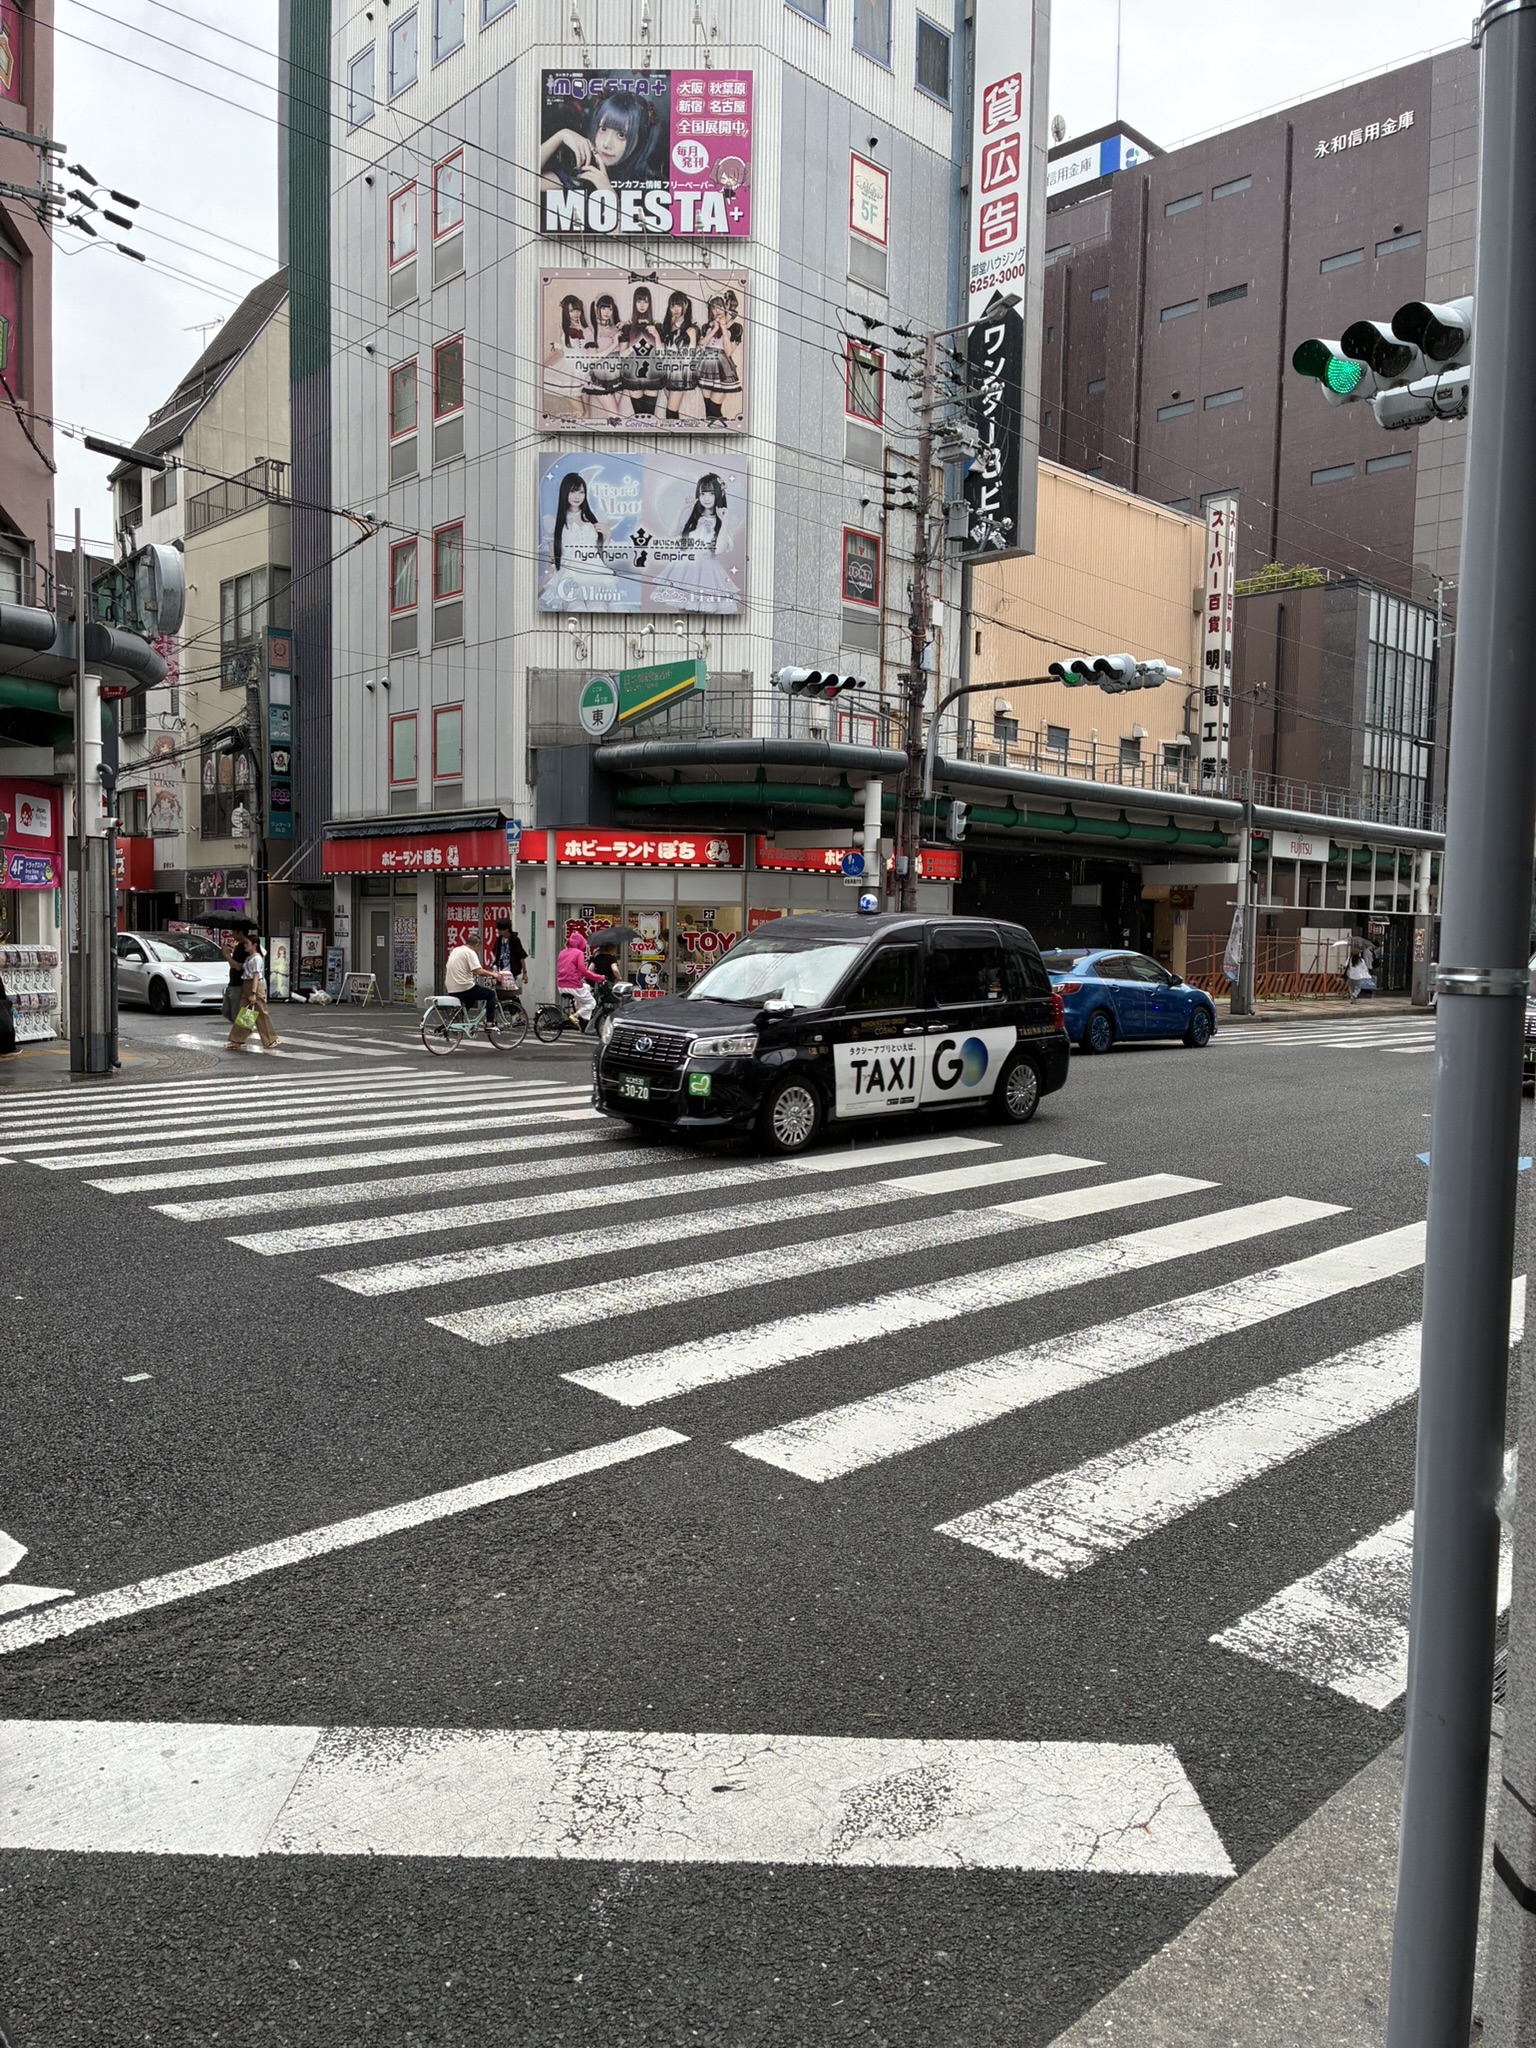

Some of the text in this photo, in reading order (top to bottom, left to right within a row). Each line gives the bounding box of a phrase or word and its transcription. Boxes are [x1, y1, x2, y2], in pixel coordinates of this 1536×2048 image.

[678, 82, 746, 95] 大阪 秋葉原
[678, 101, 746, 113] 新宿 名古屋
[1313, 110, 1415, 159] 永和信用金庫
[677, 146, 698, 156] 毎月
[682, 157, 704, 168] 発刊
[982, 78, 1020, 248] 貸広告
[861, 199, 878, 224] 5F
[971, 246, 1026, 277] 御堂ハウジング
[970, 264, 1026, 294] 6252-3000
[655, 360, 698, 372] Empire
[654, 550, 695, 562] Empire
[1202, 511, 1224, 780] スーパー百貨 明電工業
[592, 709, 604, 726] 東
[382, 848, 442, 866] ホビーランドぽち
[565, 840, 696, 859] ホビーランドぽち
[1290, 841, 1313, 857] FUJITSU
[11, 859, 24, 876] 4F
[583, 908, 592, 916] 1F
[704, 911, 714, 919] 2F
[683, 932, 736, 952] TOY
[851, 1056, 915, 1095] TAXI
[625, 1084, 649, 1100] 30-20
